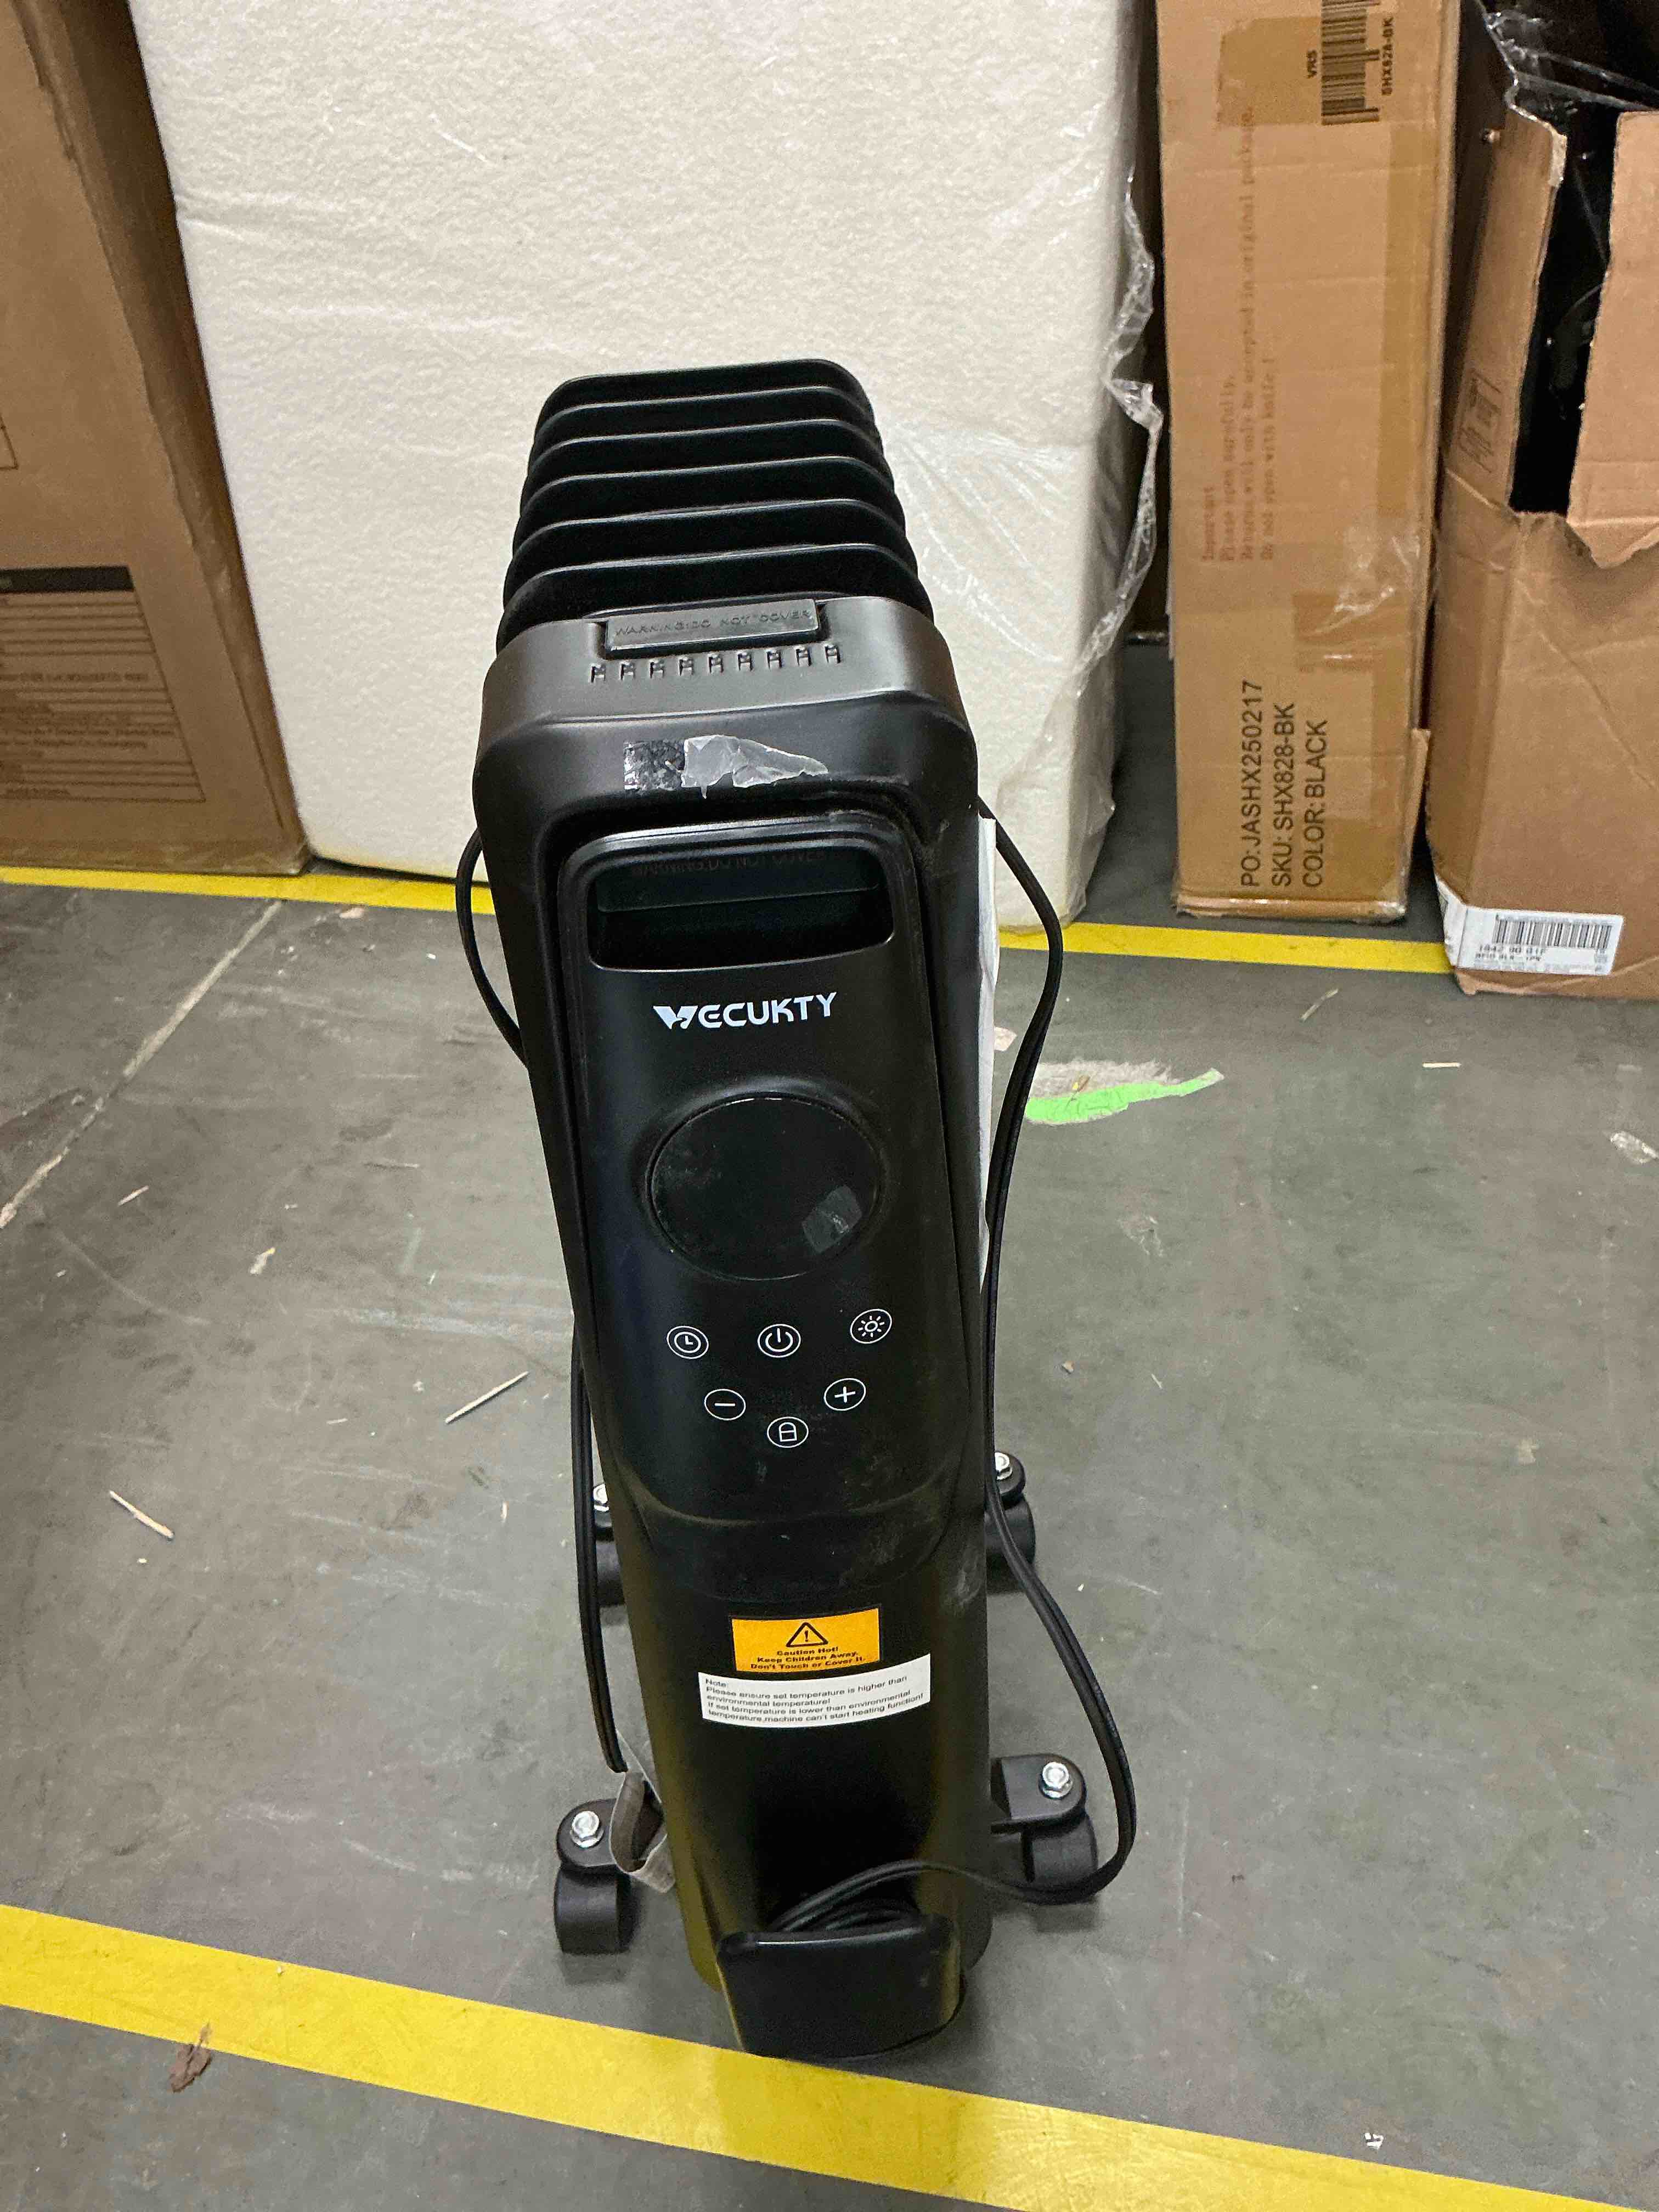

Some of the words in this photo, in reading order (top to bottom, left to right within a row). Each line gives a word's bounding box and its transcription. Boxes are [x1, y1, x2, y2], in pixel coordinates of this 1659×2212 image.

[720, 616, 751, 627] NOT
[759, 610, 810, 623] COVER
[1272, 703, 1295, 831] SHX828-BK
[653, 991, 837, 1029] WECUKTY
[785, 1655, 827, 1663] Children
[706, 1686, 737, 1697] Please
[789, 1690, 845, 1700] temperature
[857, 1681, 885, 1692] higher
[888, 1676, 907, 1685] than
[707, 1695, 770, 1707] environmental
[731, 1706, 786, 1715] temperature
[849, 1689, 911, 1709] environmental
[852, 1706, 885, 1717] heating
